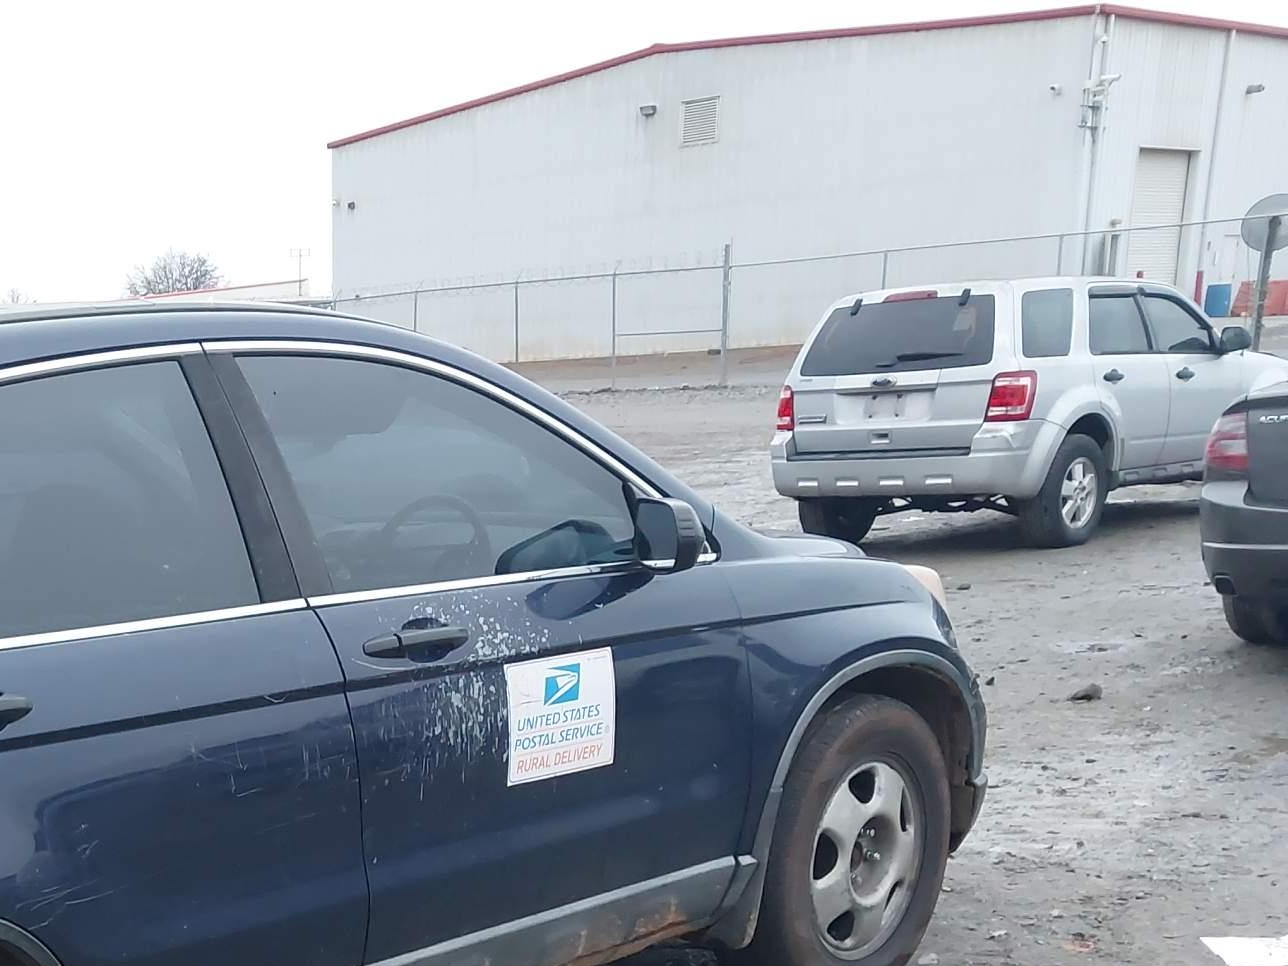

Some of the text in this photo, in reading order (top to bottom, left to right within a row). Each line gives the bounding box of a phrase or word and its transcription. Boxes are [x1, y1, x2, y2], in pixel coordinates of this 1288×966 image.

[517, 704, 601, 732] UNITED STATES
[514, 722, 604, 752] POSTAL SERVICE
[516, 744, 602, 774] RURAL DELIVERY
